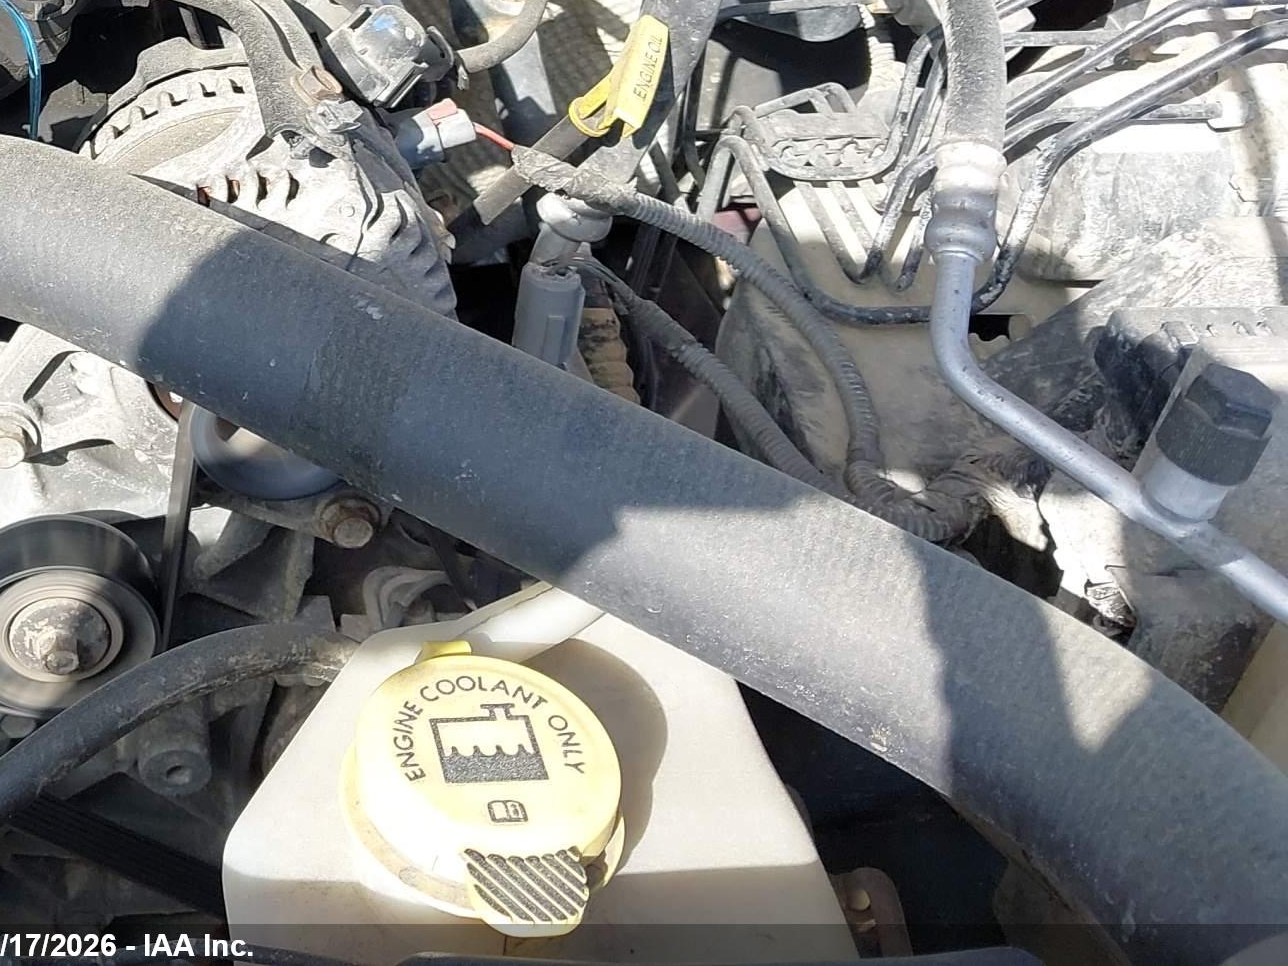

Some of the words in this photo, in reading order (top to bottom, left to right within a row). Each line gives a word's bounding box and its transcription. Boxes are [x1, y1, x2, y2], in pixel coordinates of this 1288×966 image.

[633, 52, 658, 102] ENGINE
[648, 37, 663, 54] OIL
[393, 700, 427, 782] ENGINE
[419, 675, 548, 710] COOLANT
[547, 714, 585, 774] ONLY
